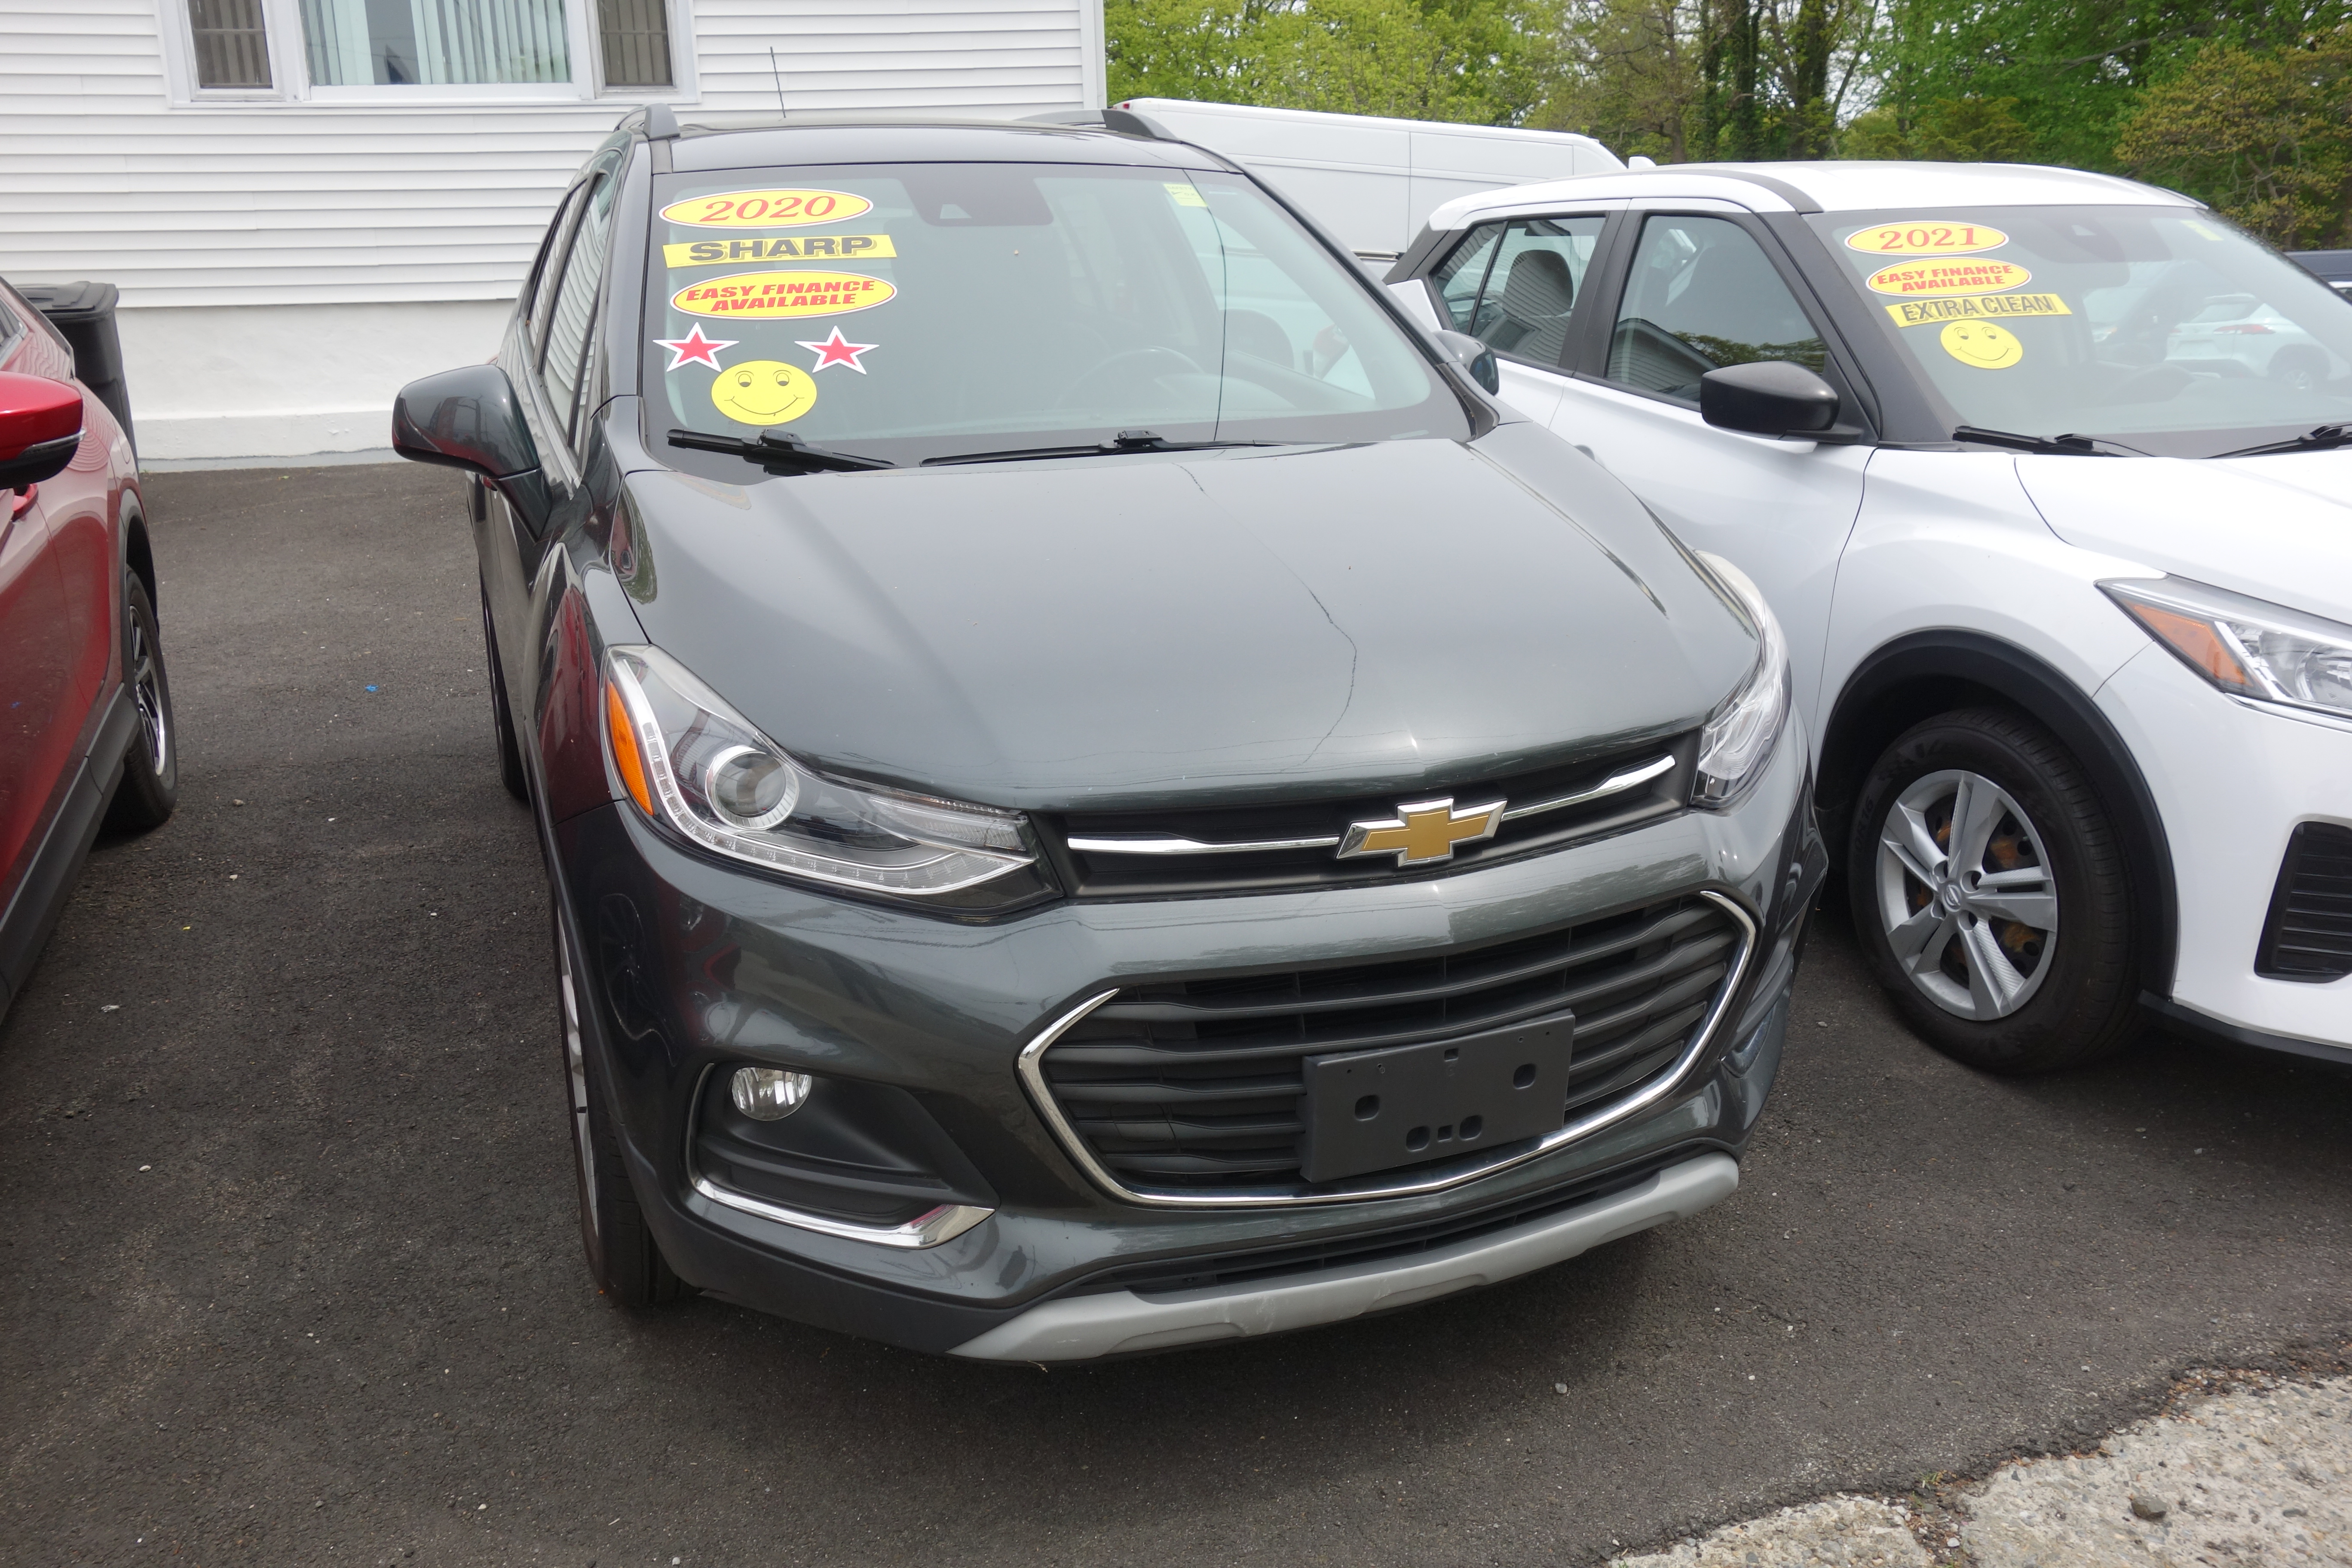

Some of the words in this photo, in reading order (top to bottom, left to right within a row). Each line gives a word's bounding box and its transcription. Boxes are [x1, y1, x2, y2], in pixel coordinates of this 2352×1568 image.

[699, 196, 836, 222] 2020
[689, 236, 874, 261] SHARP
[1879, 227, 1979, 250] 2021
[1877, 270, 1926, 285] EASY
[1932, 265, 2014, 277] FINANCE
[1902, 275, 2006, 292] AVAILABLE
[686, 285, 756, 301] EASY
[762, 280, 876, 295] FINANCE
[710, 294, 857, 312] AVAILABLE
[1901, 298, 1980, 322] EXTRA
[1981, 295, 2054, 313] CLEAN
